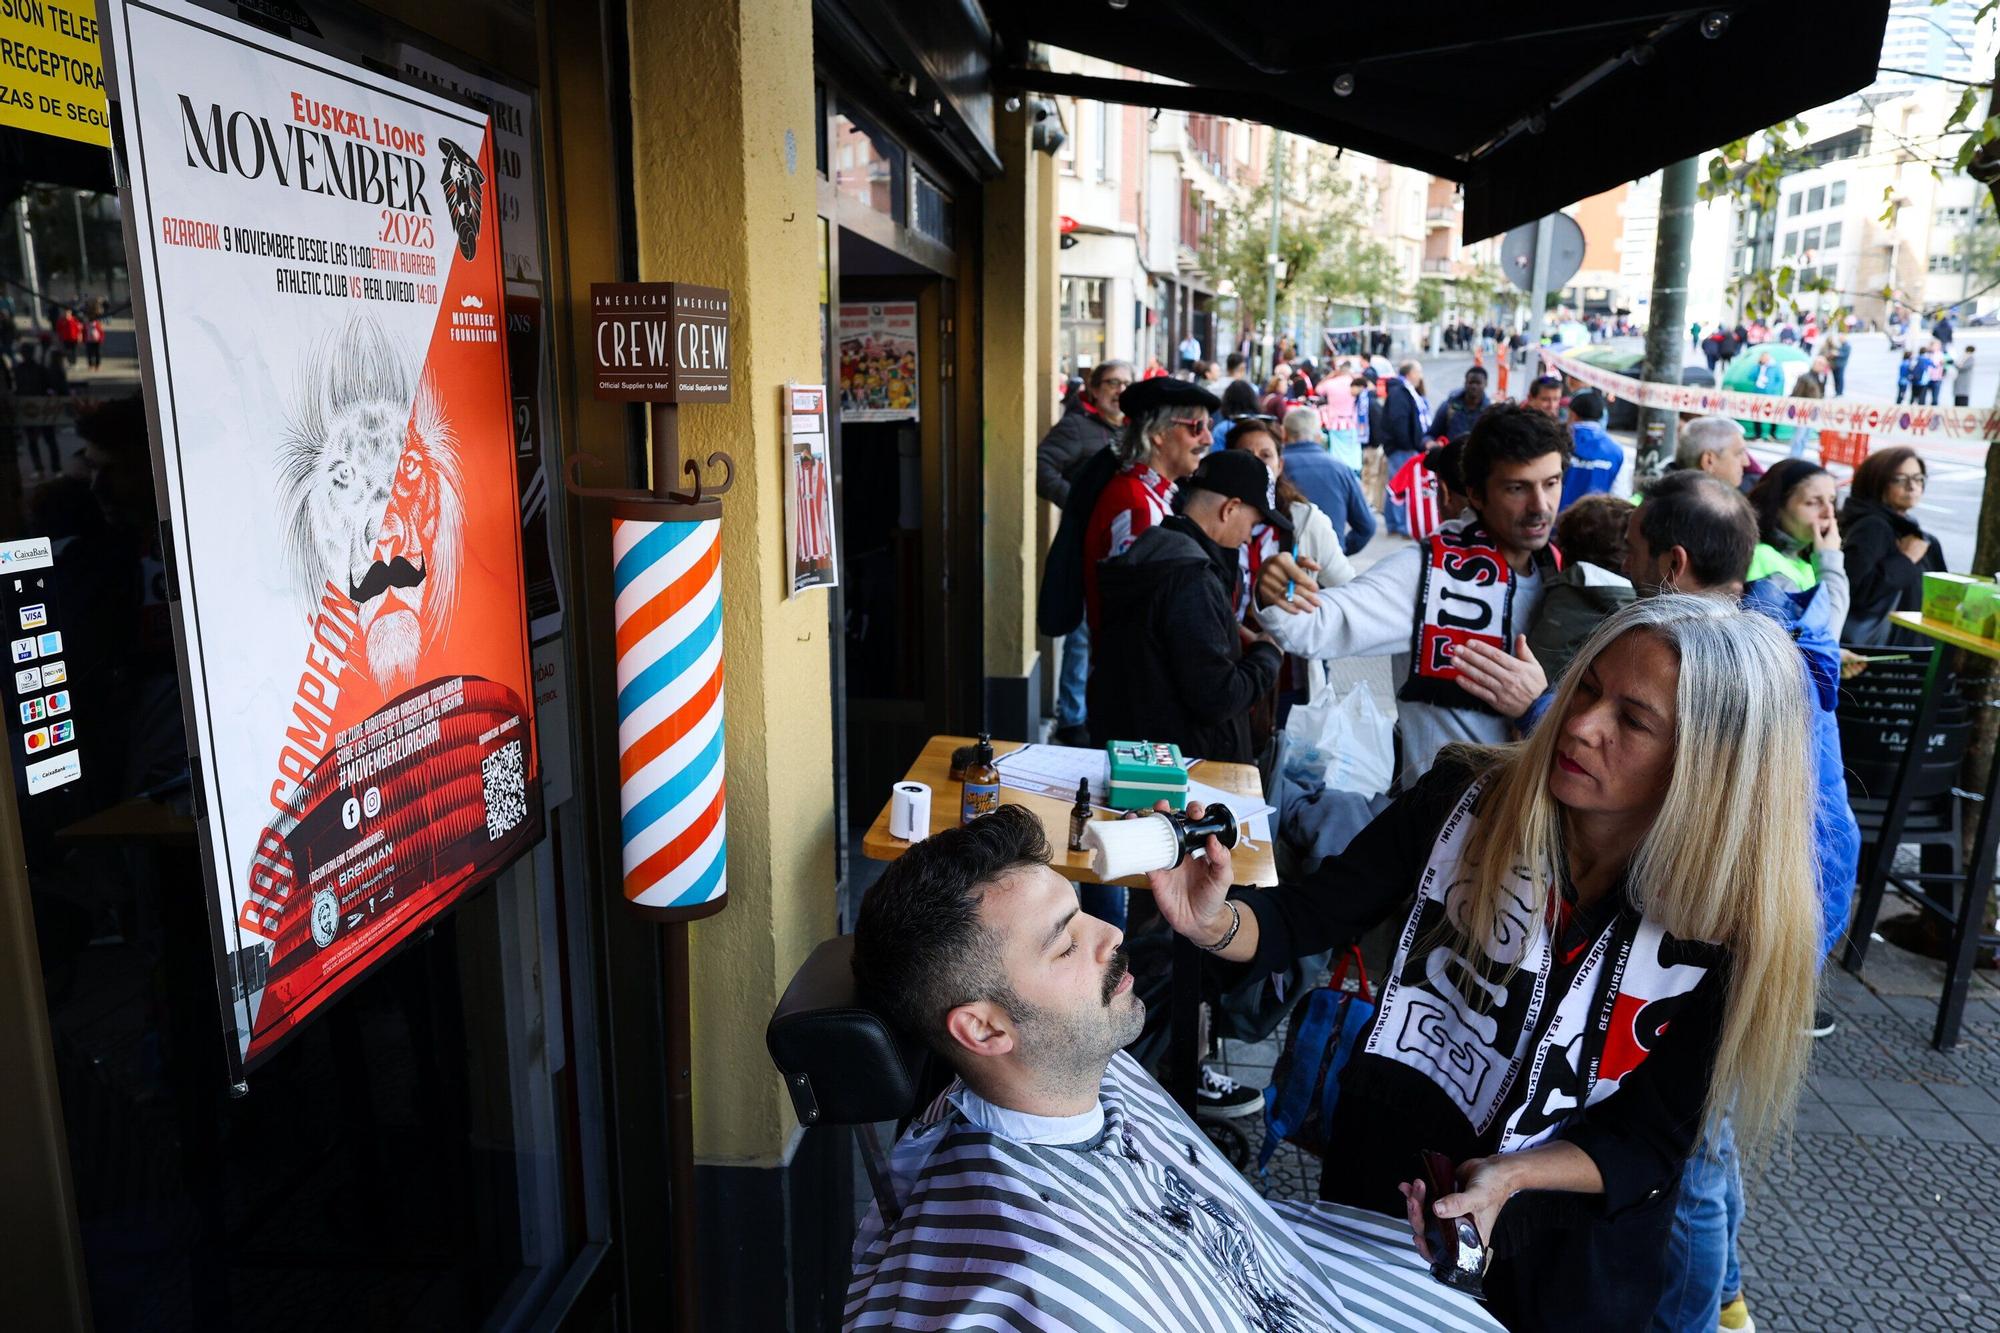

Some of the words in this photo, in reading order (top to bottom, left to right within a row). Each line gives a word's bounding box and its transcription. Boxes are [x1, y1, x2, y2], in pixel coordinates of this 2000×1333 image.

[39, 96, 62, 117] DE
[290, 91, 370, 141] EUSKAL
[373, 118, 426, 157] LIONS
[177, 93, 432, 216] MOVEMBER
[162, 216, 222, 251] AZAROAK
[223, 225, 231, 251] 9
[234, 227, 296, 261] NOVIEMBRE
[297, 236, 329, 264] DESDE
[331, 241, 348, 266] LAS
[401, 251, 436, 276] AURRERA
[276, 268, 322, 295] ATHLETIC
[323, 273, 348, 298] CLUB
[349, 276, 361, 298] VS
[363, 277, 384, 301] REAL
[385, 280, 415, 303] OVIEDO
[416, 284, 438, 305] 14:00
[595, 295, 667, 306] AMERICAN
[676, 296, 727, 312] AMERICAN
[451, 311, 495, 328] MOVEMBER
[450, 328, 498, 343] FOUNDATION
[621, 382, 646, 391] Supplier
[678, 383, 695, 391] Official
[695, 384, 713, 392] Supplier
[14, 547, 49, 559] CaixaBank
[25, 611, 42, 621] VISA
[336, 745, 355, 766] SUBE
[355, 741, 367, 757] LAS
[367, 729, 387, 753] FOTOS
[387, 725, 396, 741] DE
[396, 721, 404, 738] TU
[404, 712, 423, 734] BIGOTE
[423, 706, 434, 724] CON
[433, 703, 441, 717] EL
[440, 690, 464, 716] HASHTAG
[348, 719, 364, 742] ZURE
[338, 719, 440, 792] #MOVEMBERZURIGORRI
[338, 842, 394, 888] BREHMAN
[1598, 1004, 1613, 1031] BETI
[1606, 940, 1632, 1000] ZUREKIN!
